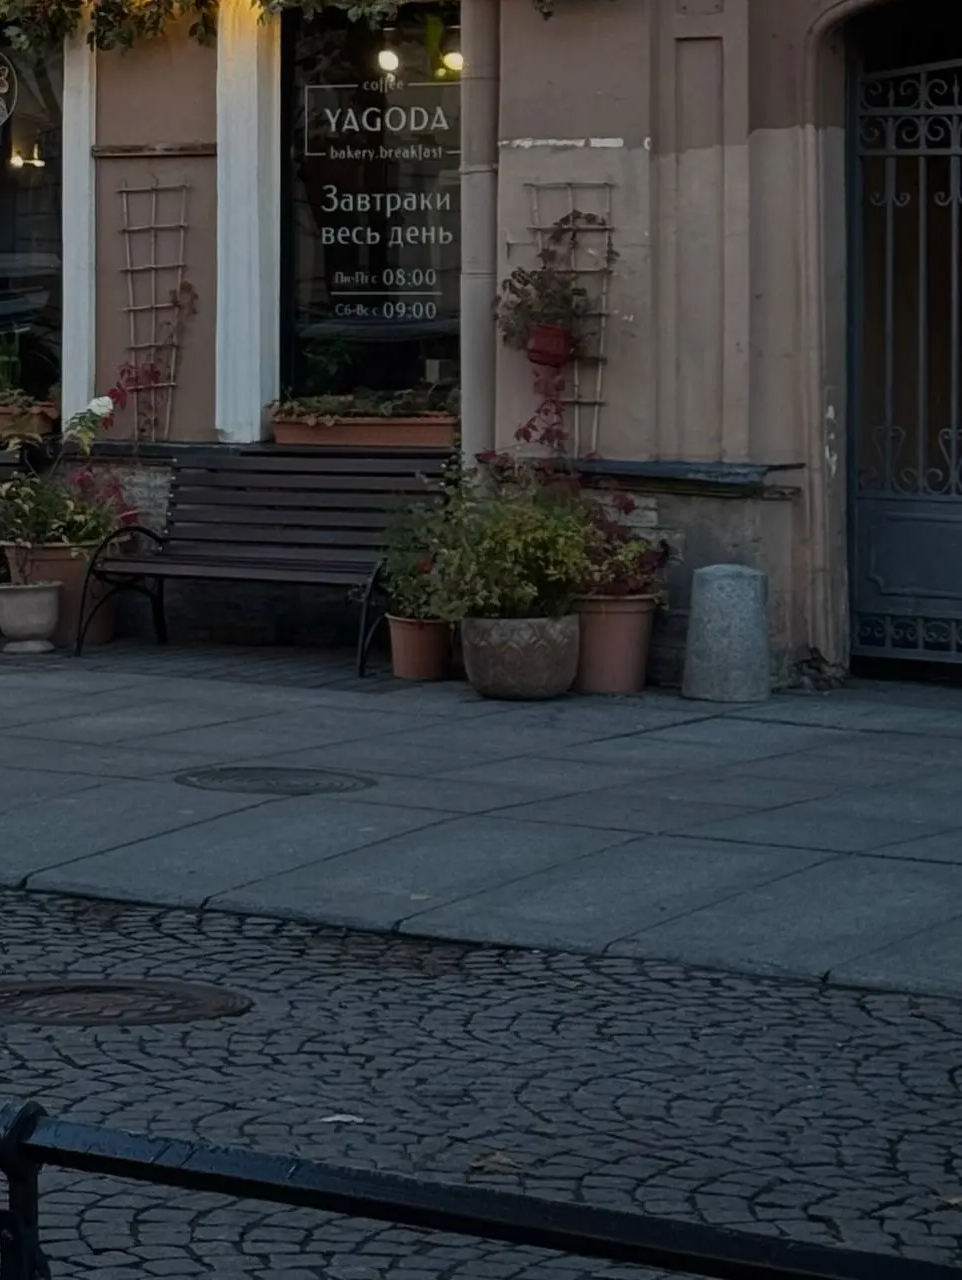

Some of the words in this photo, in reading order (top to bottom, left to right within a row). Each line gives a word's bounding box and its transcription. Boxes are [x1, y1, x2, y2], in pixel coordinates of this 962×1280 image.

[363, 76, 405, 94] coffee
[324, 106, 450, 133] YAGODA
[320, 184, 451, 219] Завтраки
[321, 226, 382, 245] весь
[387, 226, 454, 248] день
[382, 268, 437, 286] 08:00
[382, 301, 437, 319] 09:00
